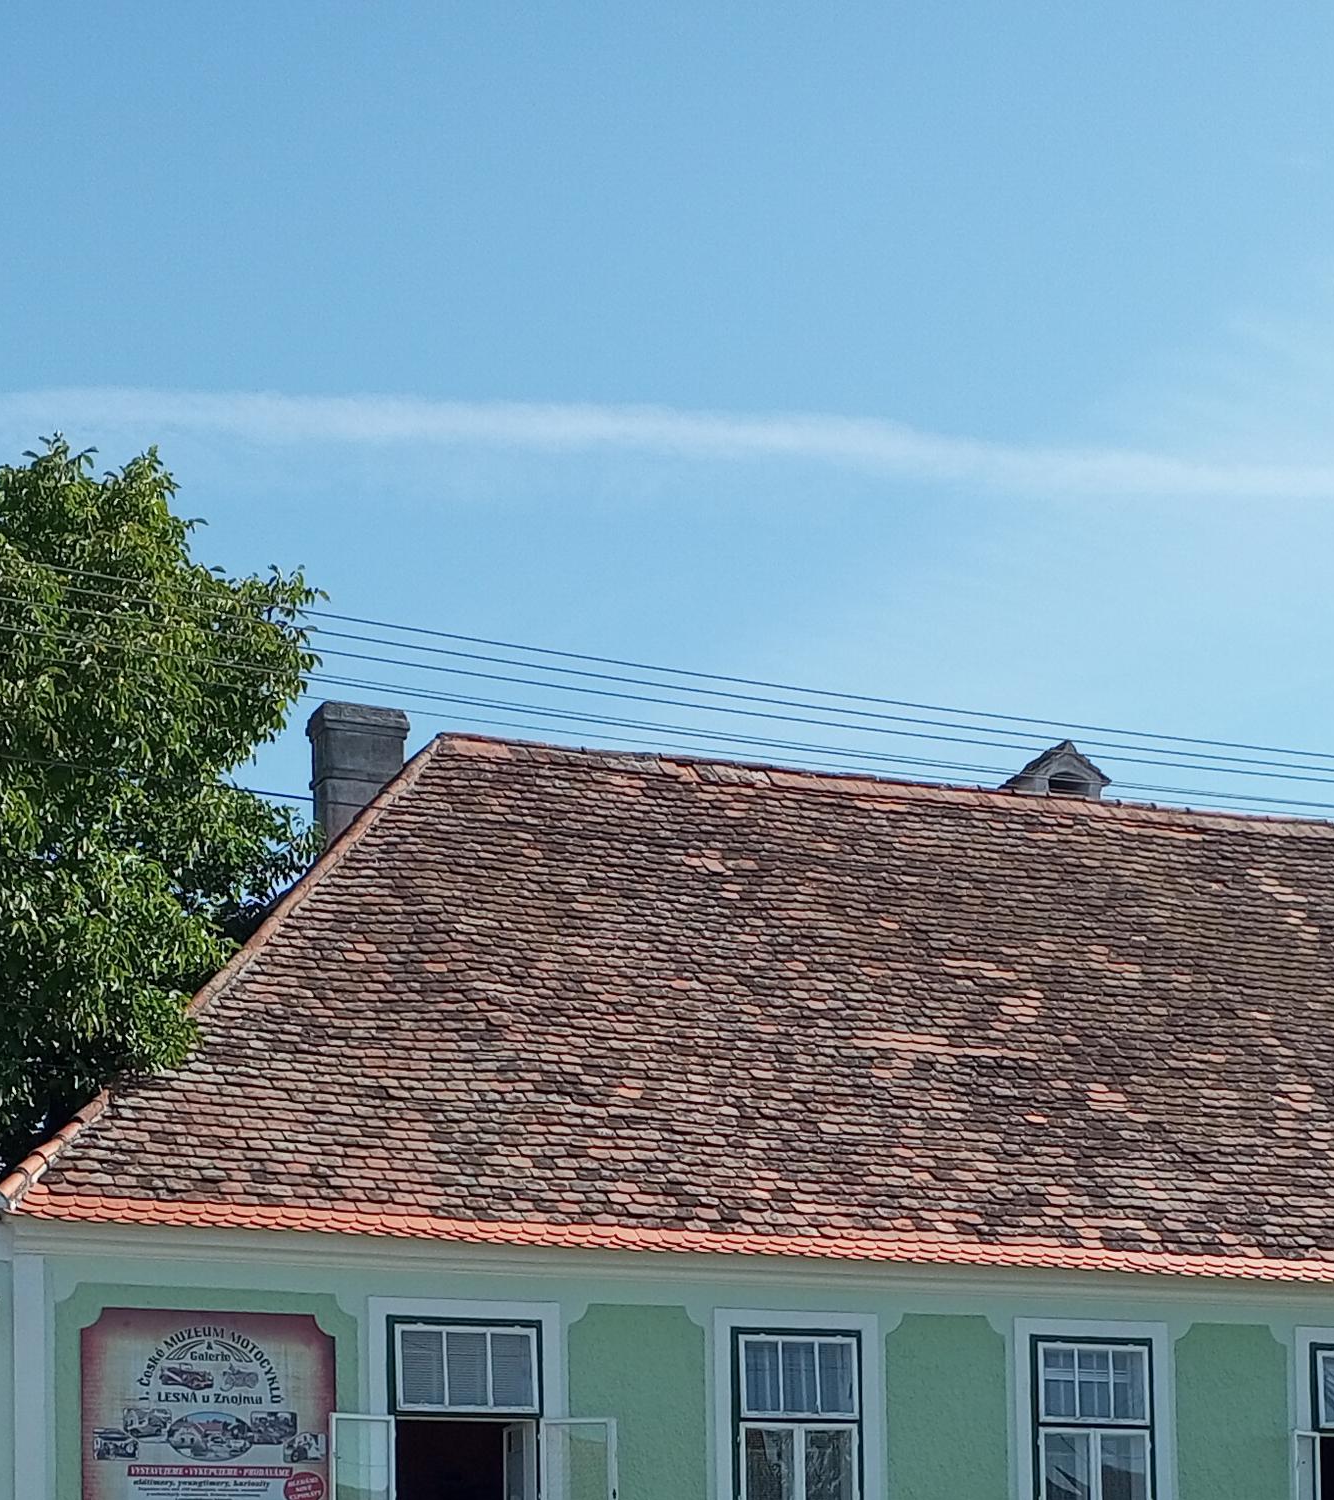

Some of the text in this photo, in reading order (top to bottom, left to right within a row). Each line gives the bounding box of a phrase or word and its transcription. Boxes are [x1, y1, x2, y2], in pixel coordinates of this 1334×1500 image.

[190, 1351, 231, 1362] Galerie
[163, 1326, 225, 1349] MUZEUM
[230, 1331, 285, 1404] MOTOCYKLŮ
[202, 1395, 210, 1404] u
[213, 1393, 263, 1406] Znojma
